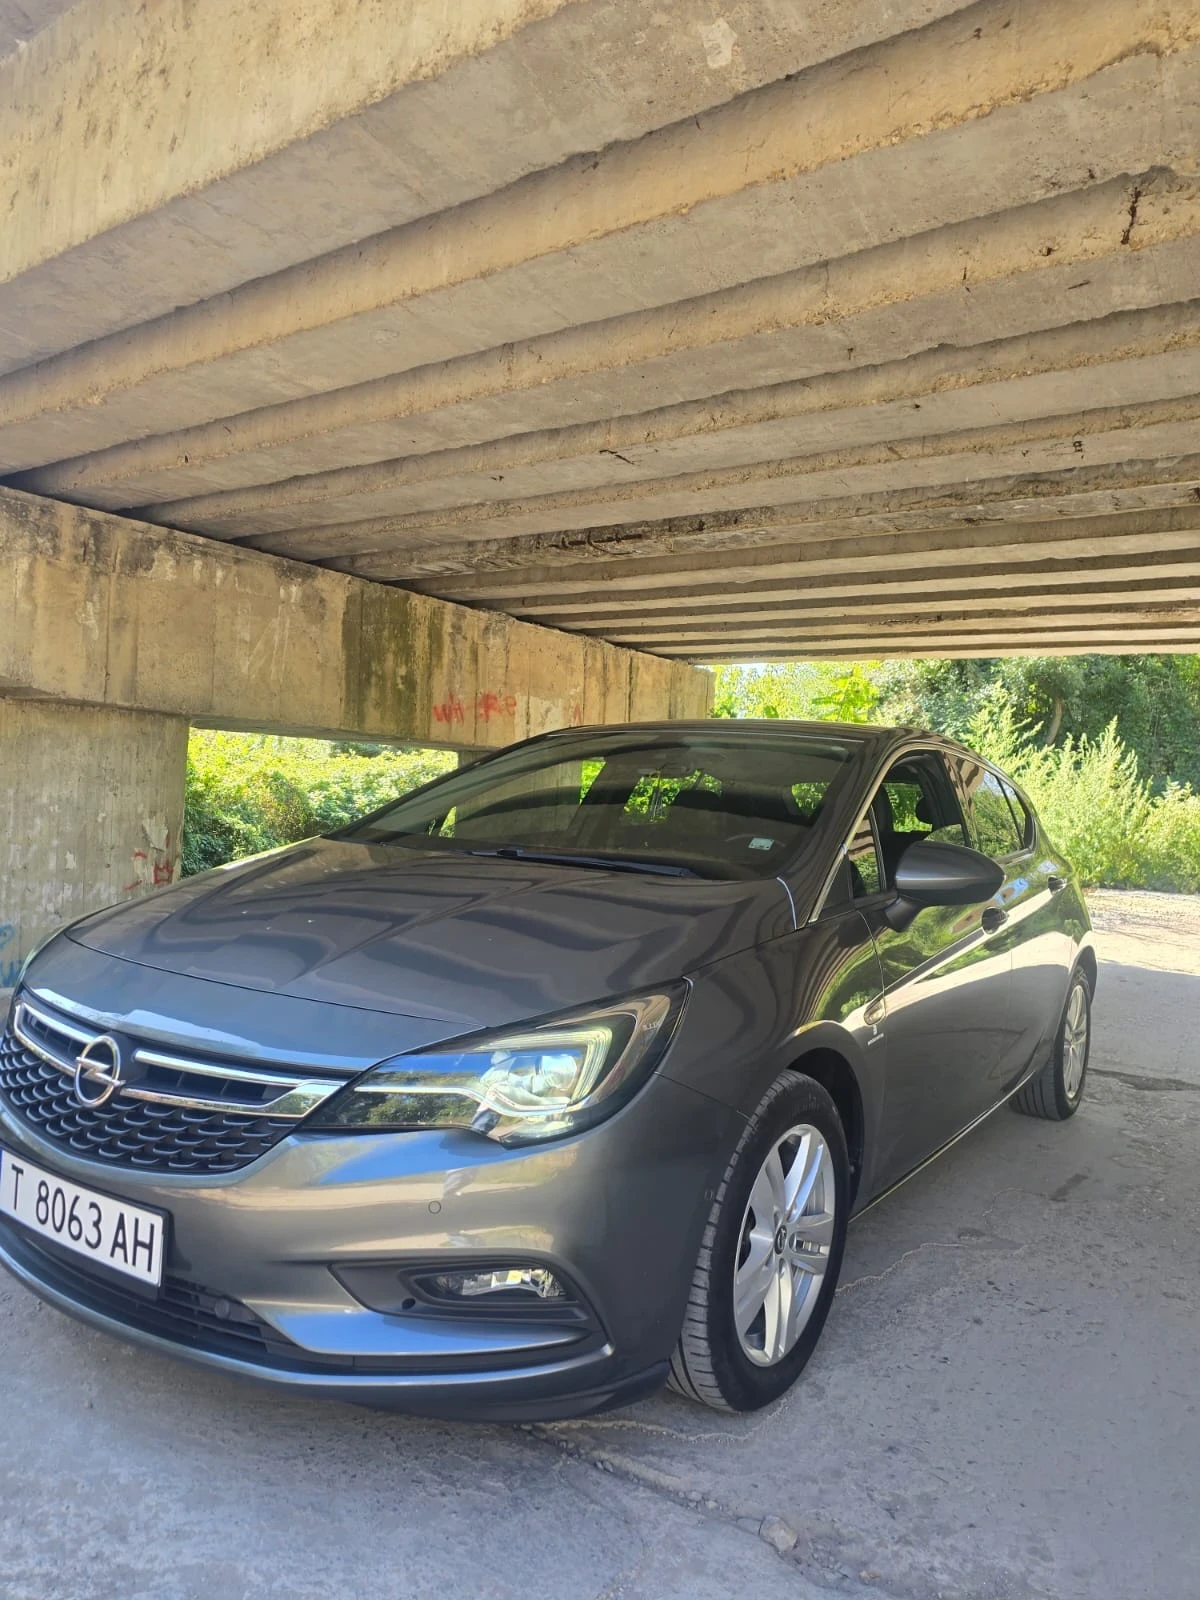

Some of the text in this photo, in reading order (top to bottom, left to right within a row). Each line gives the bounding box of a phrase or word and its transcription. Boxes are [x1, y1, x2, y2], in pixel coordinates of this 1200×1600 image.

[11, 1164, 155, 1273] T 8063 AH
